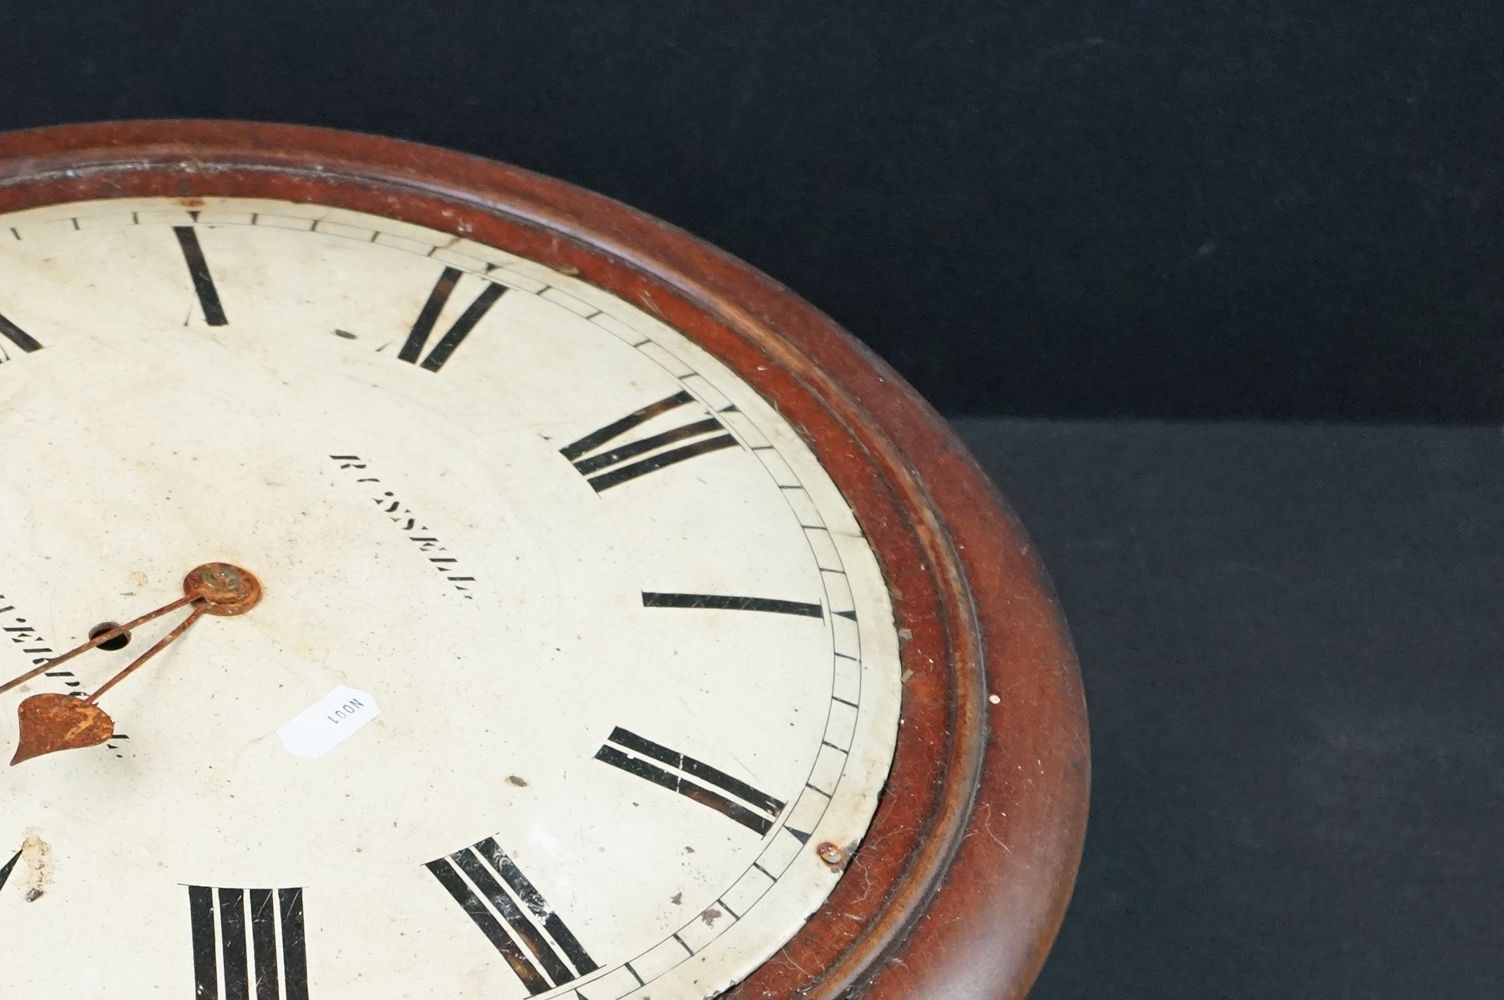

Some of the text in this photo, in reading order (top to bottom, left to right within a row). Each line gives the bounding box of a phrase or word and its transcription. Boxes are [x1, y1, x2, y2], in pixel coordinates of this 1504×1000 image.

[328, 454, 476, 600] RUSSELL
[327, 698, 365, 725] N001
[593, 725, 788, 839] II
[422, 832, 606, 999] III
